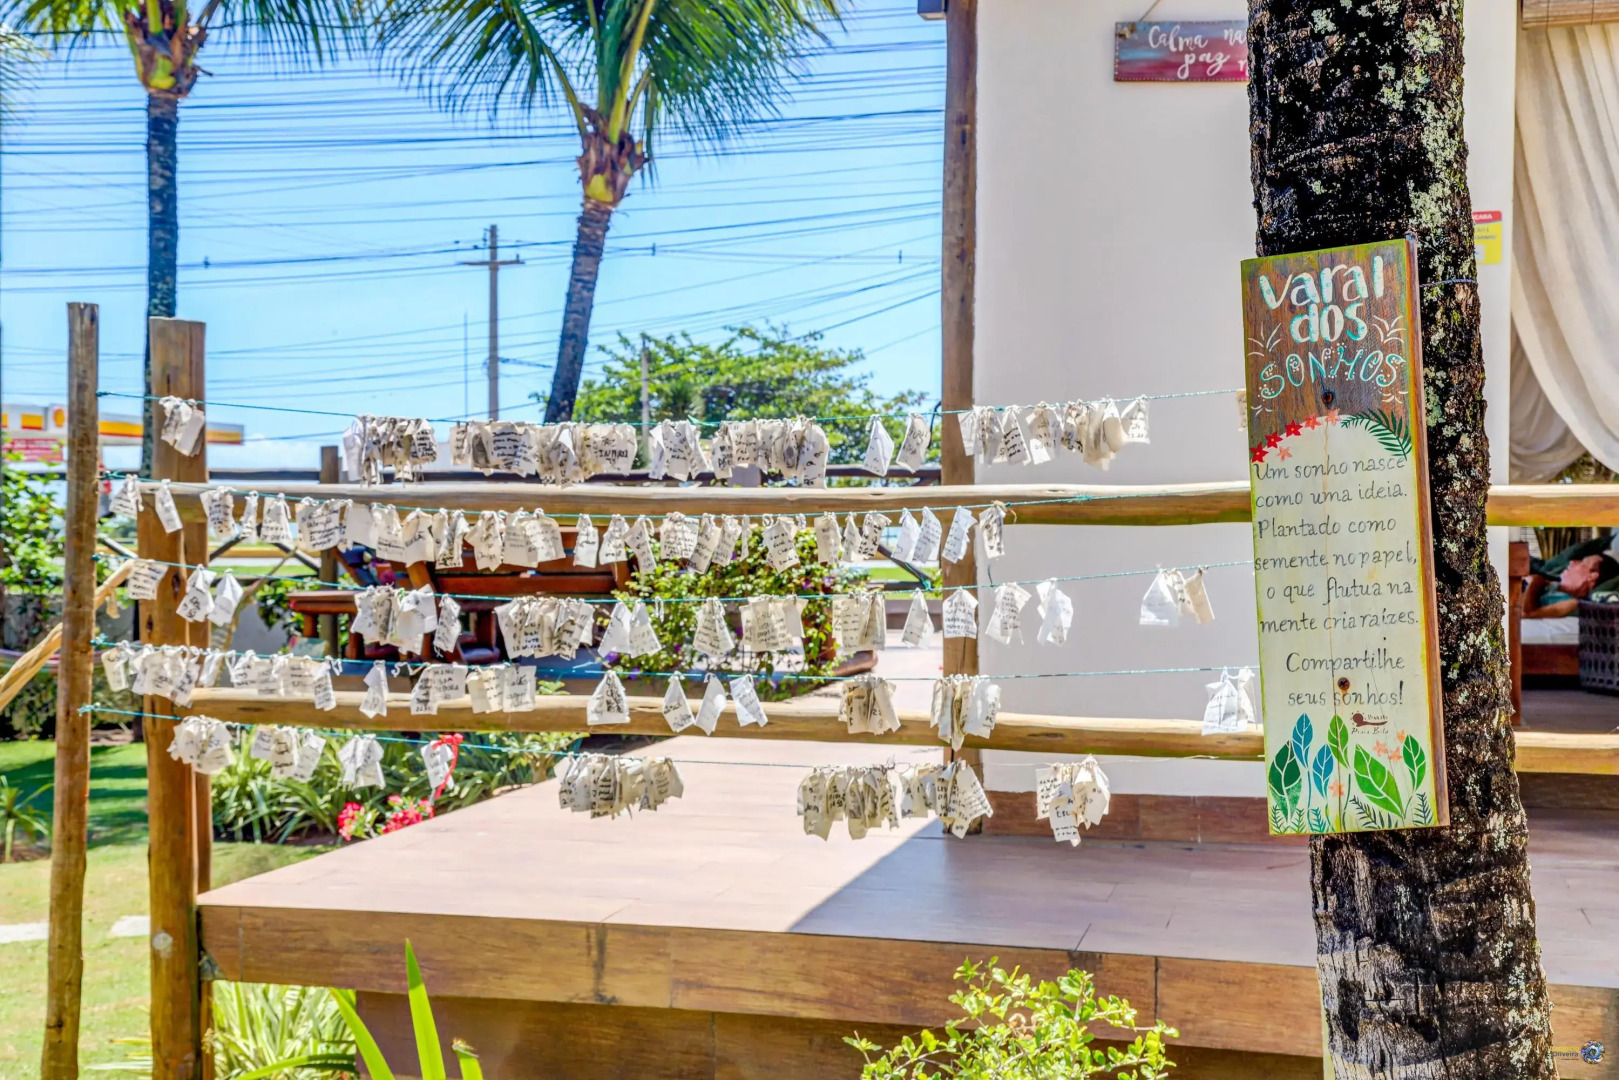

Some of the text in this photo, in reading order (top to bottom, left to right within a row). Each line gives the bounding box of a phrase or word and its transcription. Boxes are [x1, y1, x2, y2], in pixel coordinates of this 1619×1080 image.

[1148, 25, 1208, 52] Calma
[1177, 51, 1230, 79] paz
[1290, 302, 1368, 343] dos
[1259, 345, 1407, 399] SONHOS
[1253, 455, 1406, 480] Um sonho nasce
[1255, 480, 1408, 508] como uma ideia.
[1258, 515, 1397, 539] Plantado como
[1254, 549, 1328, 571] semente
[1266, 576, 1413, 605] o que flutua na
[1260, 612, 1318, 633] mente
[1286, 648, 1405, 677] Compartilhe
[1288, 680, 1404, 706] seus sonhos!
